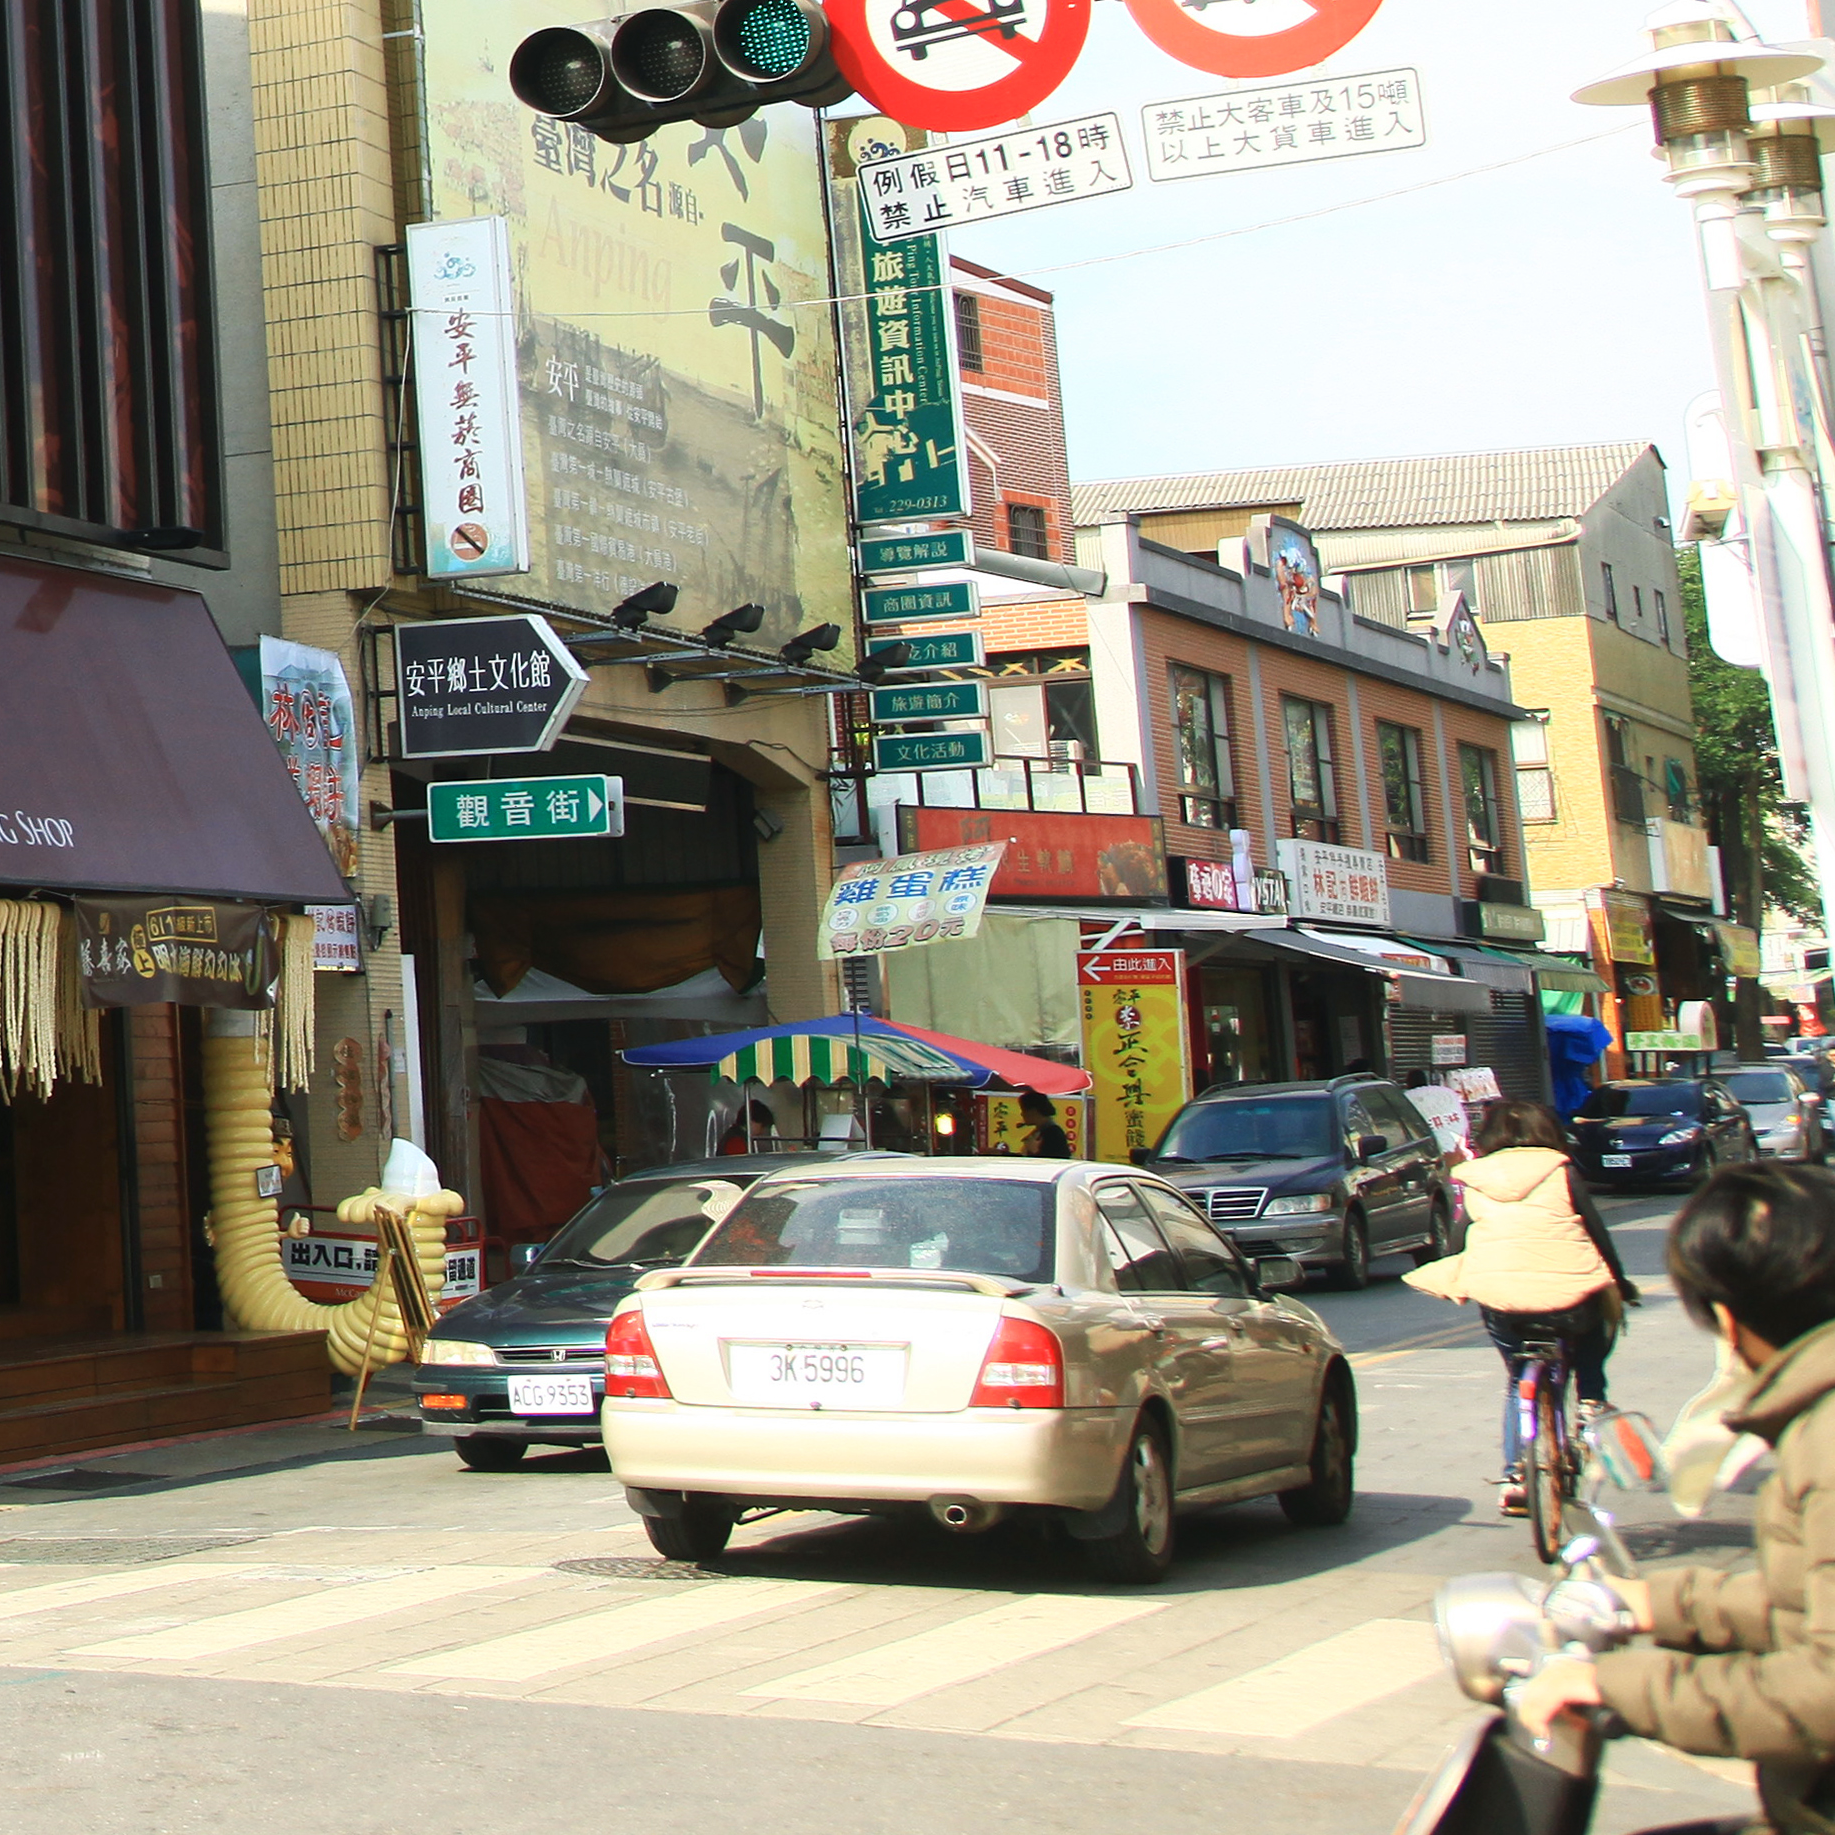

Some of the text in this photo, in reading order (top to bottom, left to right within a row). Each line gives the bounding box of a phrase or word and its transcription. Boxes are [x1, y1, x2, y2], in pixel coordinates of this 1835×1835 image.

[1163, 109, 1413, 166] 以上大貨車進入
[873, 125, 1112, 199] 例假日11-18時
[878, 159, 1118, 231] 禁止汽車進入
[538, 194, 673, 325] Anping
[870, 241, 920, 455] 旅遊資訊中心
[914, 298, 927, 365] Information
[546, 354, 579, 402] 安平
[916, 365, 929, 404] Center
[889, 495, 949, 512] 229-0313
[883, 591, 953, 613] 商圈資訊
[908, 641, 958, 661] 吃介紹
[406, 649, 551, 697] 安平鄉土文化館
[411, 700, 548, 720] Anping Local Cultural Center
[897, 741, 965, 762] 文化活動
[16, 810, 75, 849] SHOP
[455, 789, 580, 829] 觀音街
[833, 864, 989, 907] 雞蛋糕
[1113, 957, 1172, 972] 由此進入
